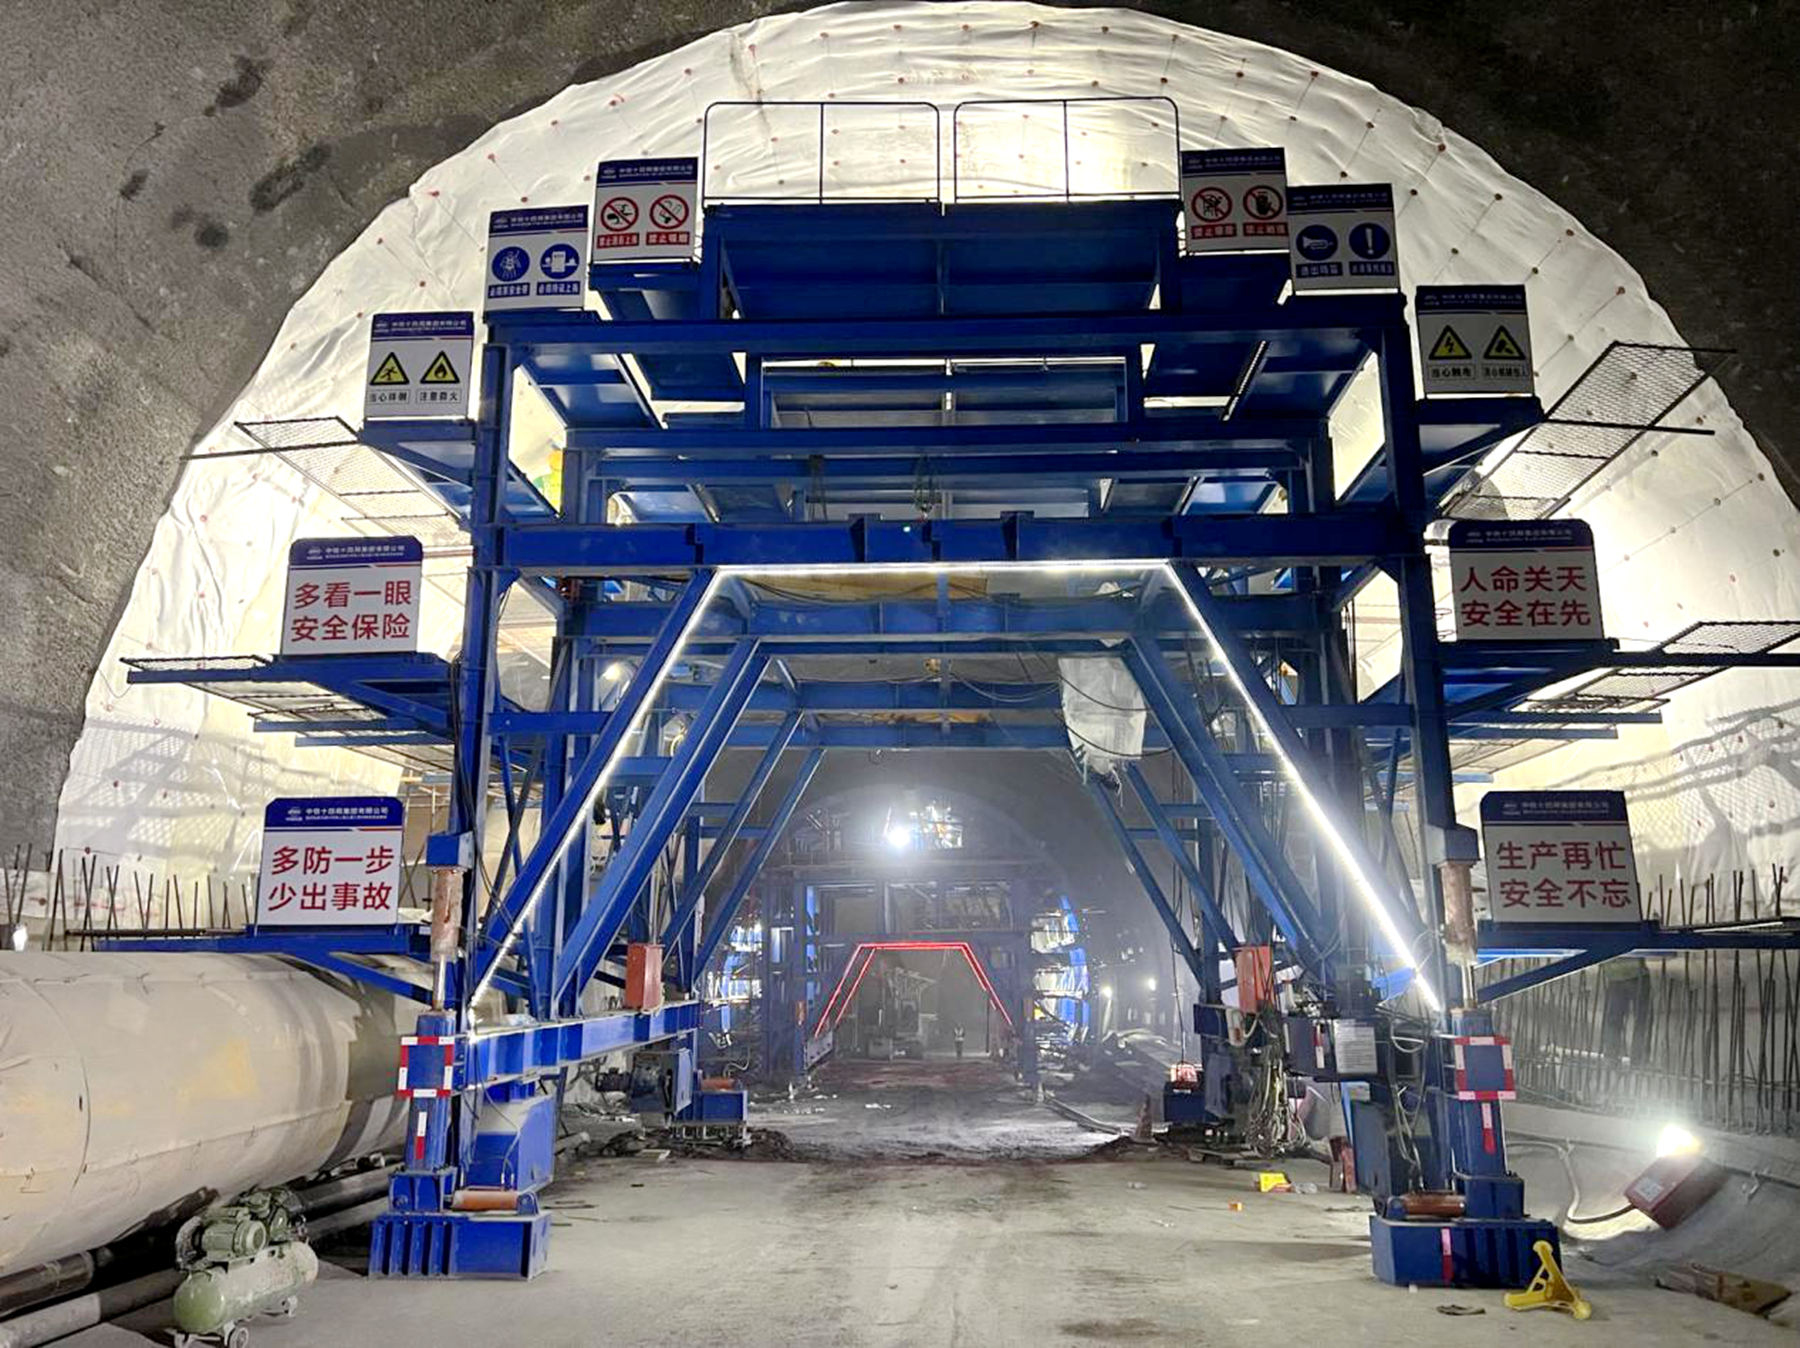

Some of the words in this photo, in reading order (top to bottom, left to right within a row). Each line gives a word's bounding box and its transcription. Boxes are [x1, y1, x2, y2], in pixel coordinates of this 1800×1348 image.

[1460, 565, 1587, 593] 人命关天
[294, 580, 411, 609] 多看一眼
[291, 613, 410, 642] 安全保险
[1461, 599, 1591, 627] 安全在先
[271, 845, 394, 875] 多防一步
[1496, 841, 1626, 870] 生产再忙
[268, 881, 392, 911] 少出事故
[1500, 878, 1631, 909] 安全不忘
